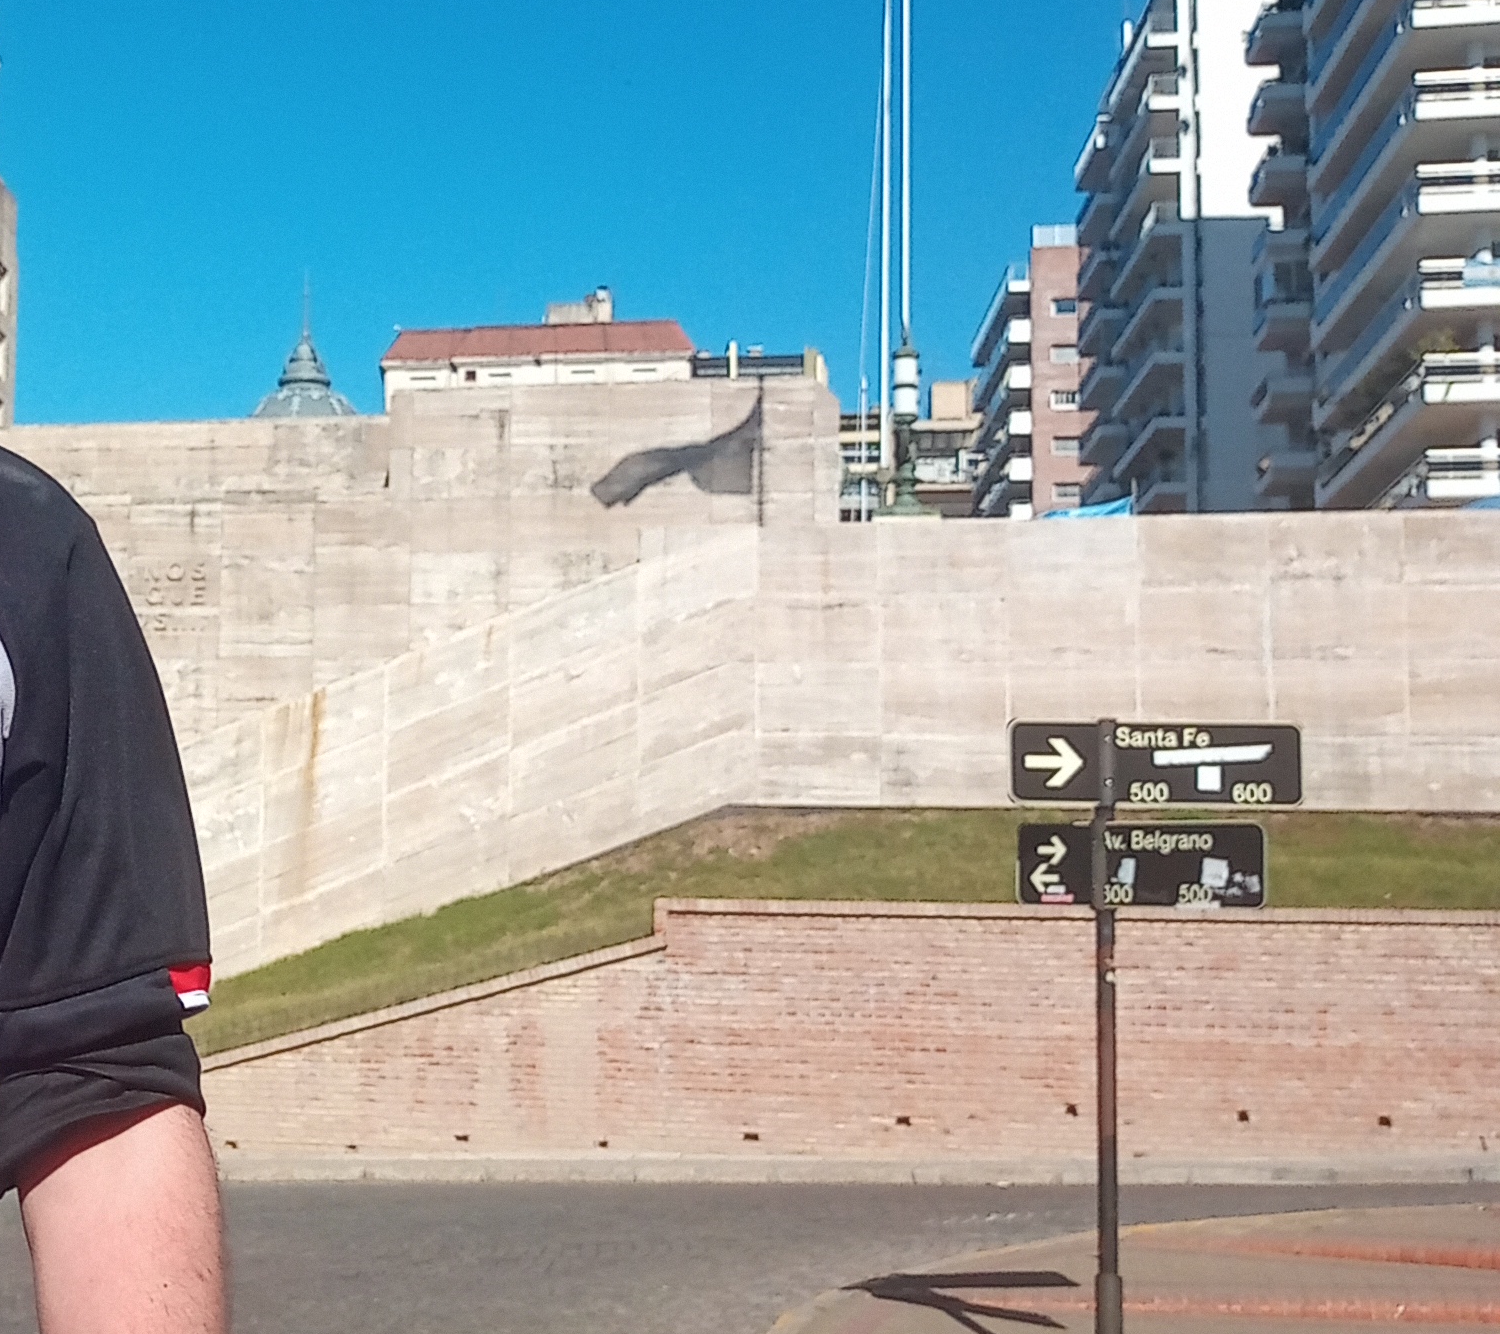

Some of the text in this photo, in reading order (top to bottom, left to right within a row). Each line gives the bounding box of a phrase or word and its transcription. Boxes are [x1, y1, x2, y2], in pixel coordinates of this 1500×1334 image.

[1115, 726, 1212, 749] Santa Fe
[1129, 781, 1274, 804] 500 600
[1130, 829, 1214, 856] Belgrano
[1178, 883, 1213, 904] 500
